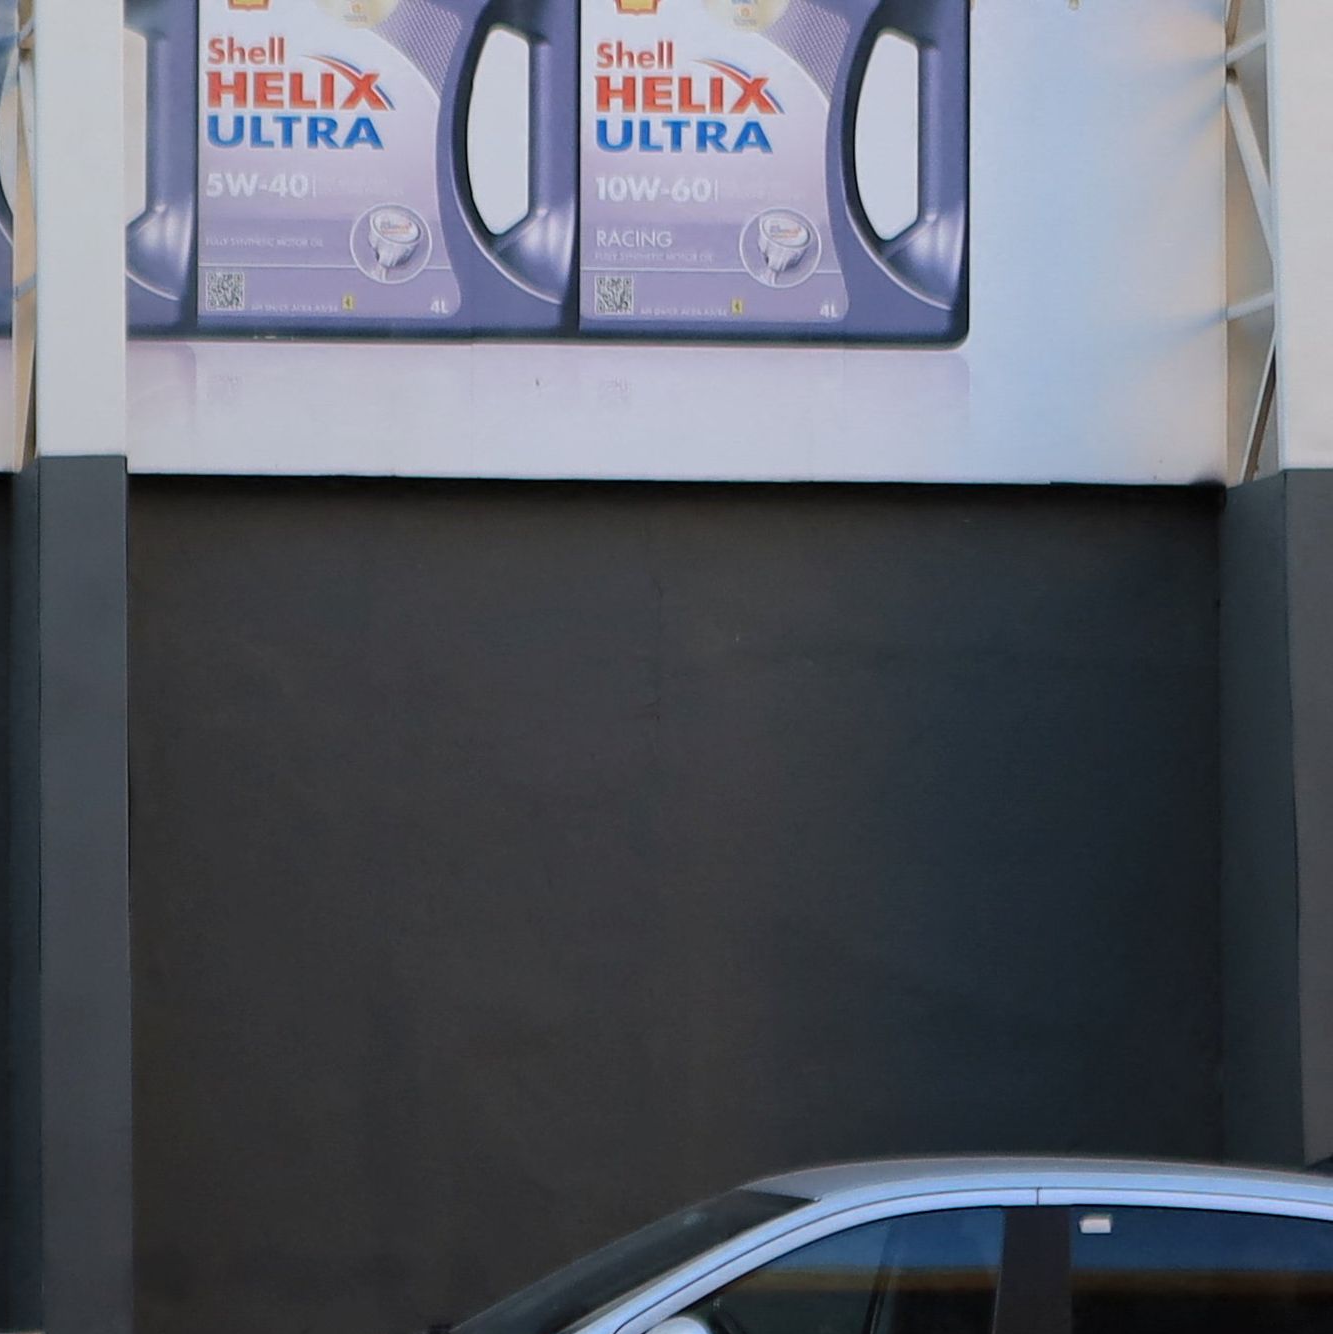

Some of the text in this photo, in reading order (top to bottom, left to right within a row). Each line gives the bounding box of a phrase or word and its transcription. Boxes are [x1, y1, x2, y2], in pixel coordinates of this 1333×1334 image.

[207, 37, 285, 65] Shell
[596, 41, 673, 69] Shell
[205, 71, 392, 110] HELIX
[595, 75, 783, 115] HELIX
[206, 115, 385, 150] ULTRA
[596, 120, 773, 154] ULTRA
[205, 173, 309, 198] 5W-40
[595, 177, 712, 202] 10W-60
[596, 231, 673, 248] RACING
[430, 300, 449, 314] 4L
[819, 304, 838, 318] 4L
